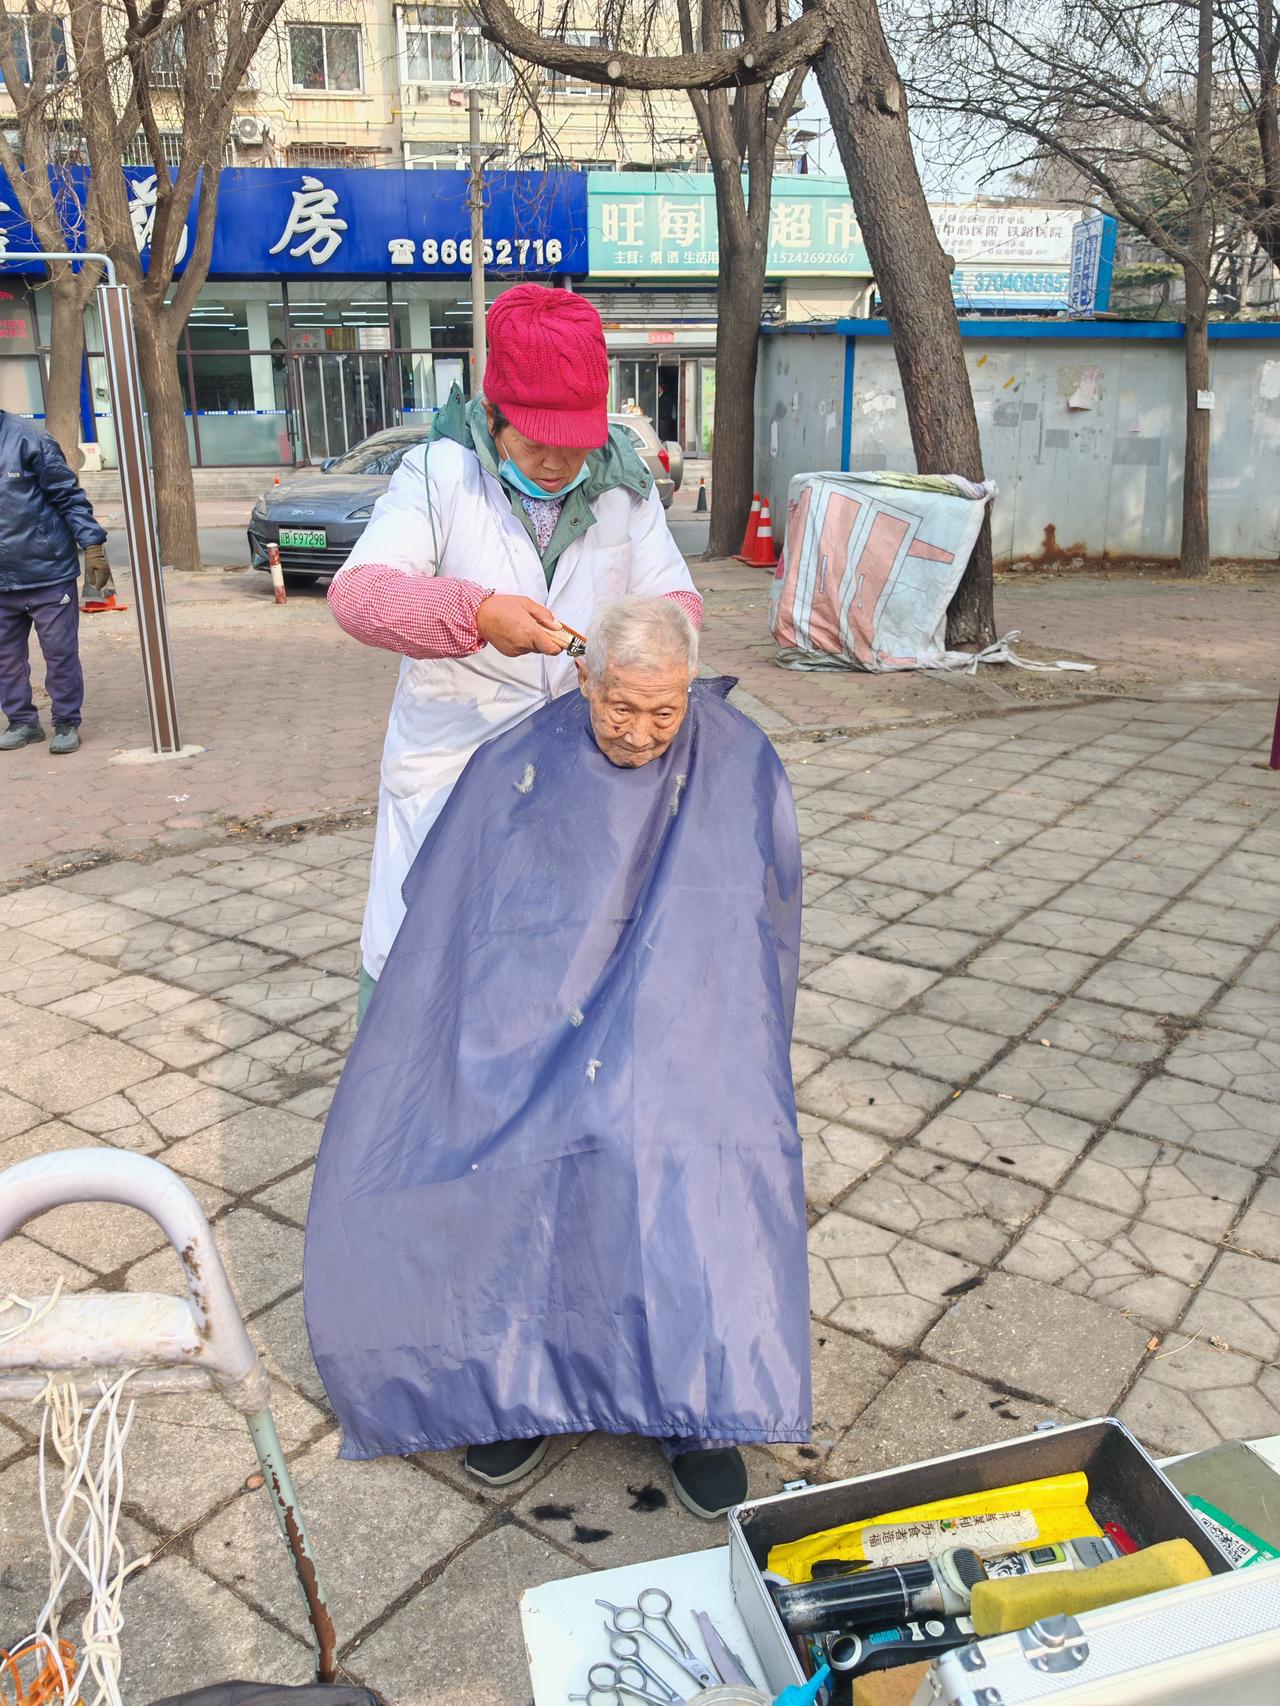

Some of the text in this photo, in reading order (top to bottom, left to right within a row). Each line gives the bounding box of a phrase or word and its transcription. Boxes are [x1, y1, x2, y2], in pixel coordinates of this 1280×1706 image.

[602, 201, 864, 247] 旺每超市
[422, 238, 562, 265] 86652716
[773, 252, 855, 264] 15242692667
[868, 1522, 933, 1548] 为食者造福
